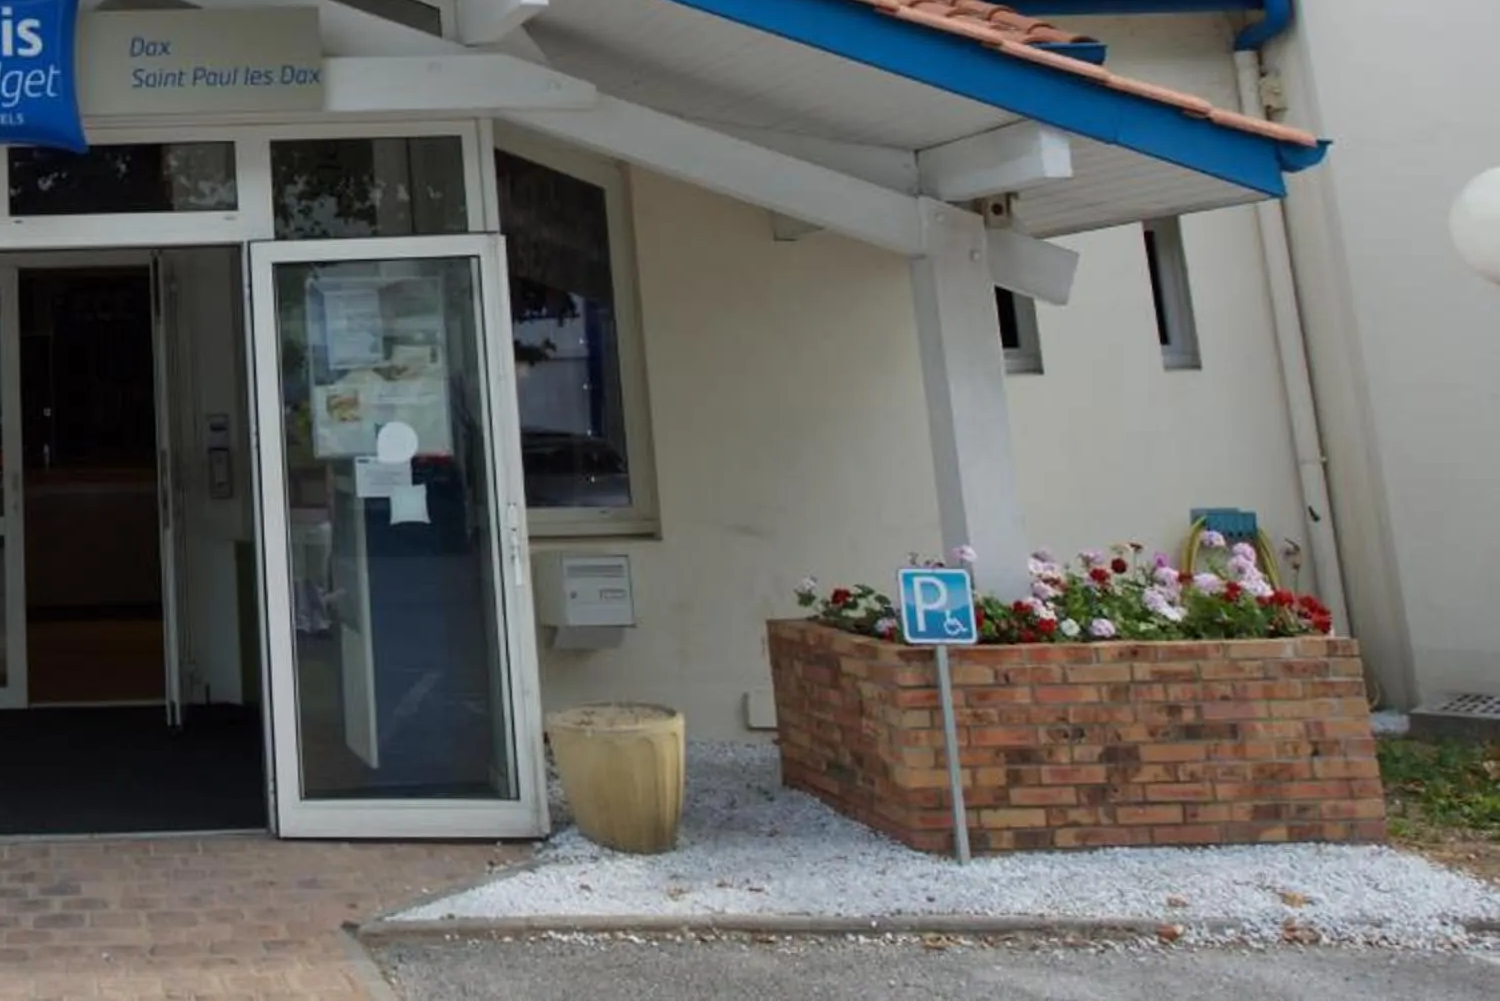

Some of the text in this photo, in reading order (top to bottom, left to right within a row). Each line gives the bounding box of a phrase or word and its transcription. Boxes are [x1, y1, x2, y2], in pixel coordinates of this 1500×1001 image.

[129, 36, 172, 57] Dax
[132, 64, 322, 88] Saint Paul les Dax
[913, 576, 948, 632] P
